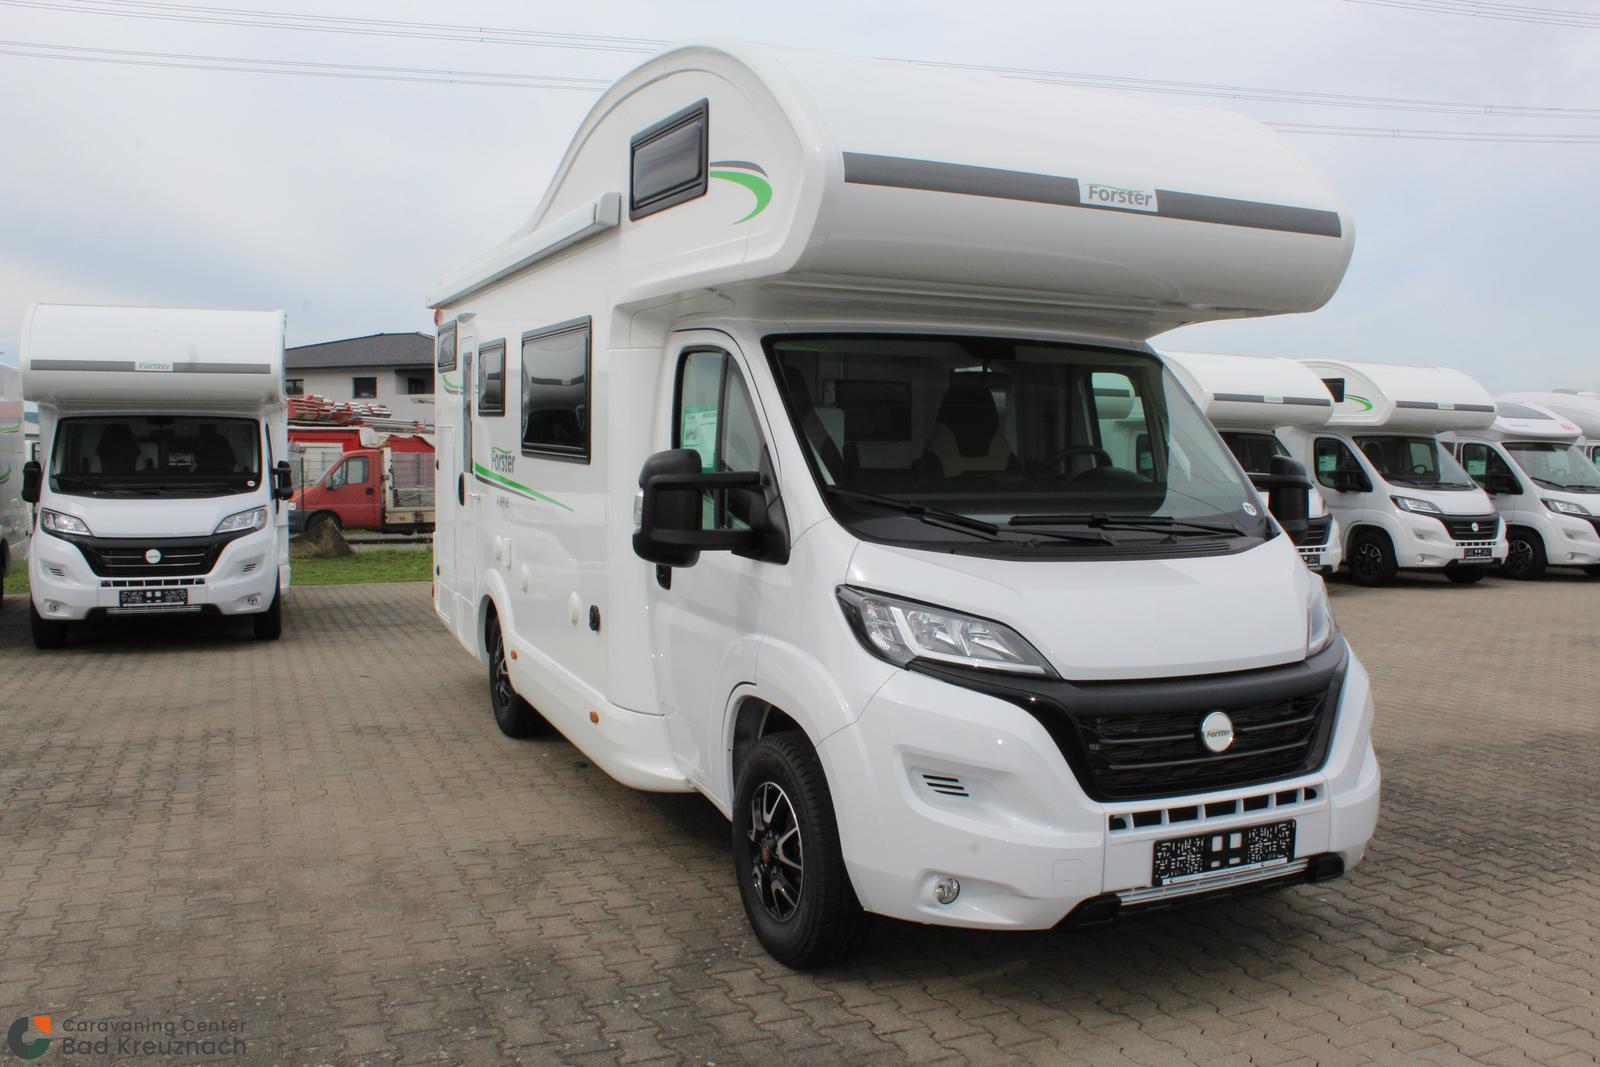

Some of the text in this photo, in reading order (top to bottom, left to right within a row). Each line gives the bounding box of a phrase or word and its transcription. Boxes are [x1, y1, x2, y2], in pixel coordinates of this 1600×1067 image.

[1088, 184, 1153, 206] Forster
[138, 361, 172, 370] Forster
[491, 448, 515, 473] Forster
[1206, 729, 1230, 739] Forster
